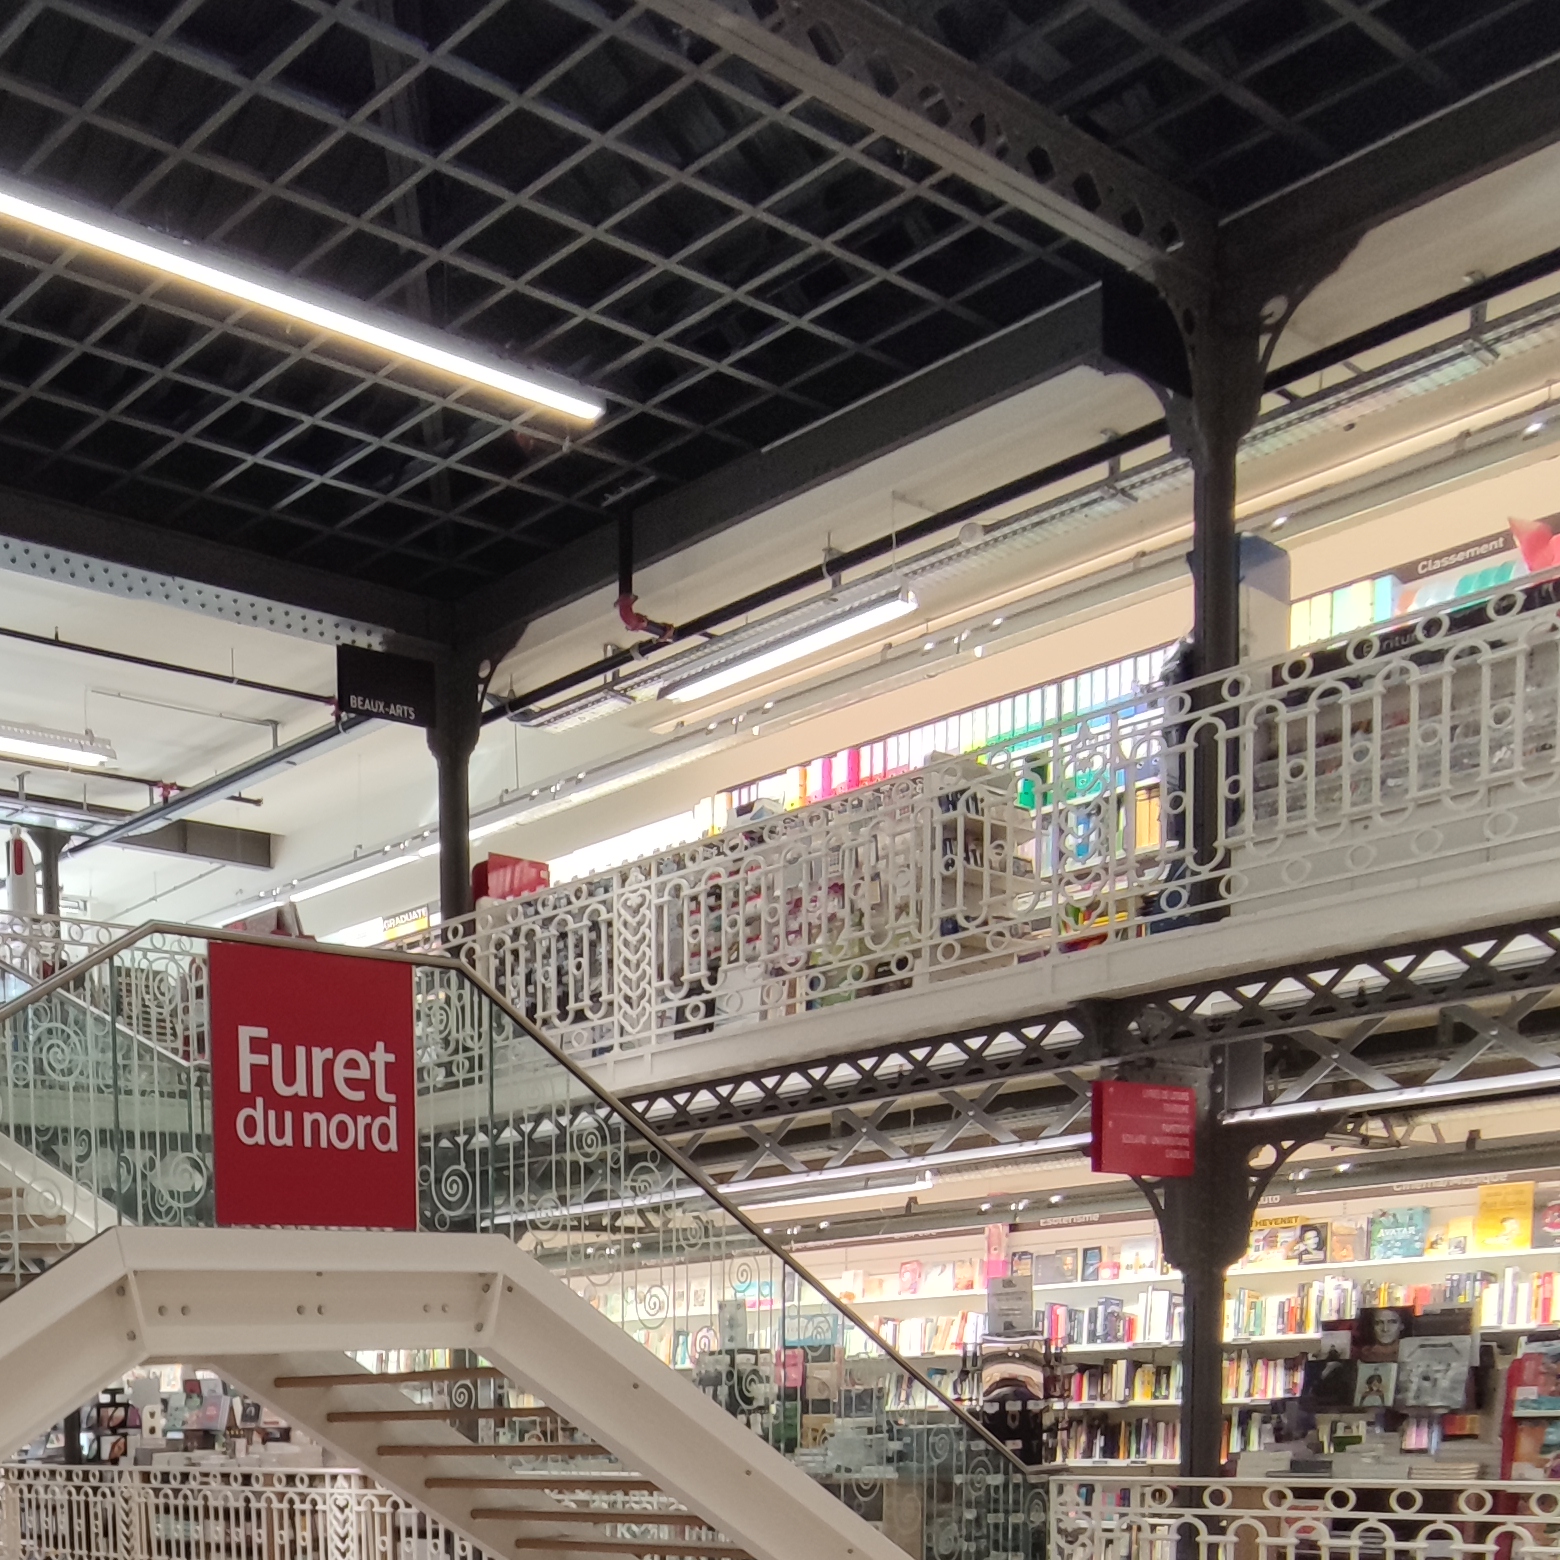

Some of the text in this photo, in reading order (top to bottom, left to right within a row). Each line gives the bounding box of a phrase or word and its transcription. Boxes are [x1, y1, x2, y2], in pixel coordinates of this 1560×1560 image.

[1417, 536, 1506, 575] Classement
[349, 694, 416, 720] BEAUX-ARTS
[237, 1024, 397, 1104] Furet
[235, 1096, 399, 1153] du nord
[1376, 1226, 1417, 1239] AVATAR
